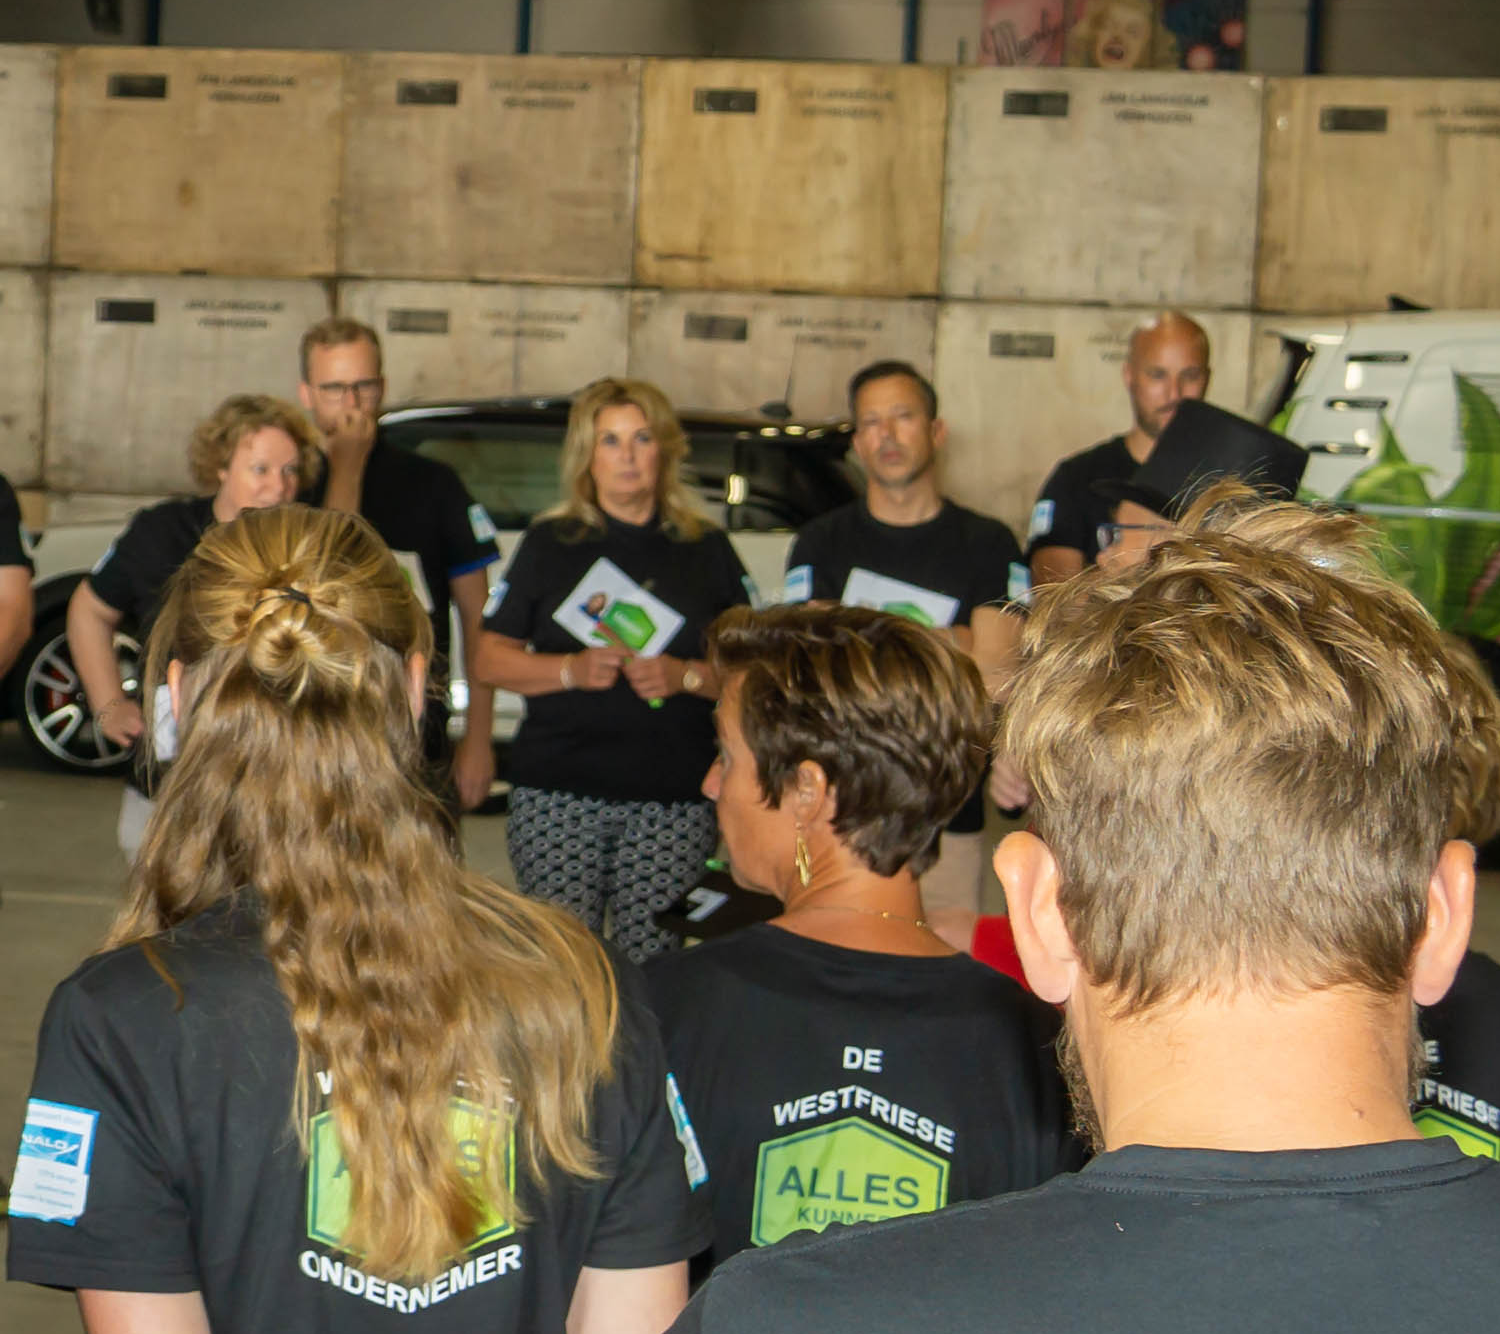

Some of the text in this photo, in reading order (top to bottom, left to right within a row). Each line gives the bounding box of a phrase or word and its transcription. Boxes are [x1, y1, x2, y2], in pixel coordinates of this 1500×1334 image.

[843, 1045, 883, 1073] DE
[773, 1084, 955, 1154] WESTFRIESE
[776, 1164, 920, 1209] ALLES
[300, 1243, 522, 1314] ONDERNEMER
